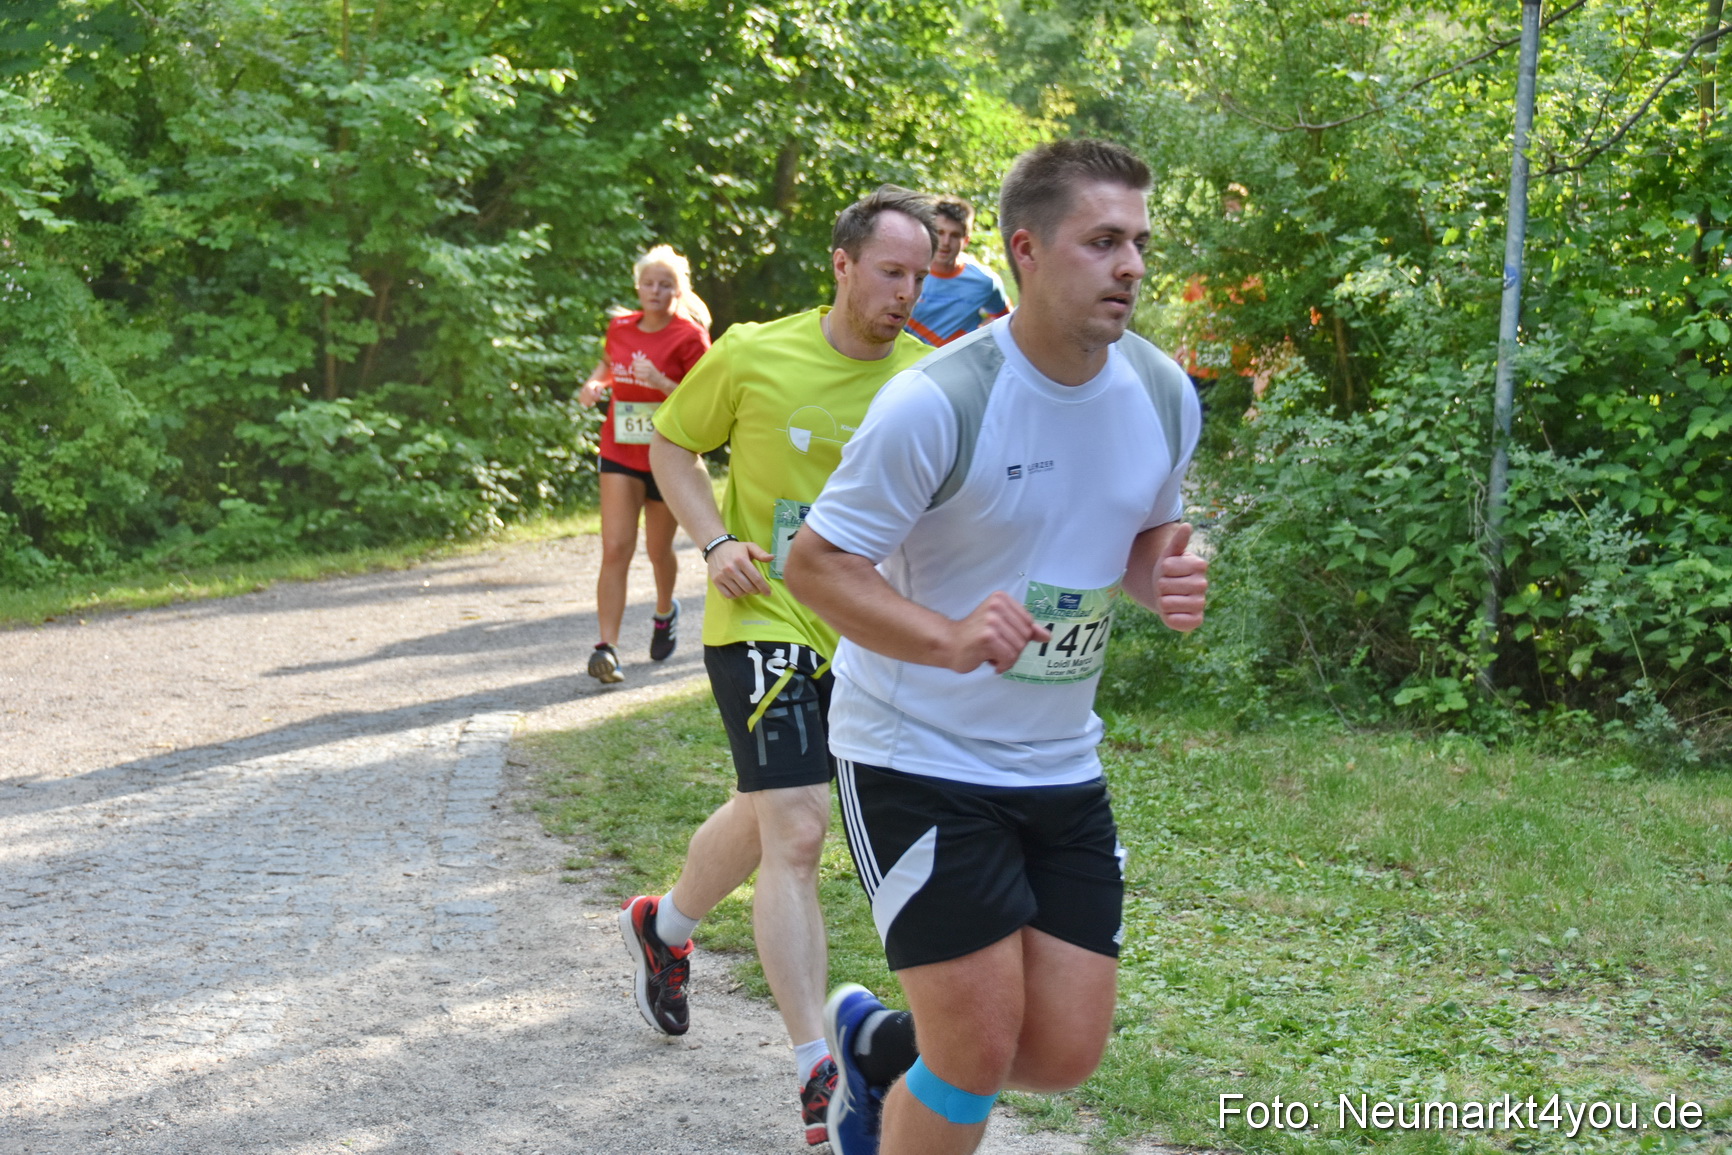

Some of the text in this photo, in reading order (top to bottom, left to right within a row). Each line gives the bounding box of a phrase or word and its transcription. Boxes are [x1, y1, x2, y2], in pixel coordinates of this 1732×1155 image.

[625, 417, 655, 432] 613
[1038, 615, 1110, 658] 1472
[1046, 659, 1070, 669] Loidl
